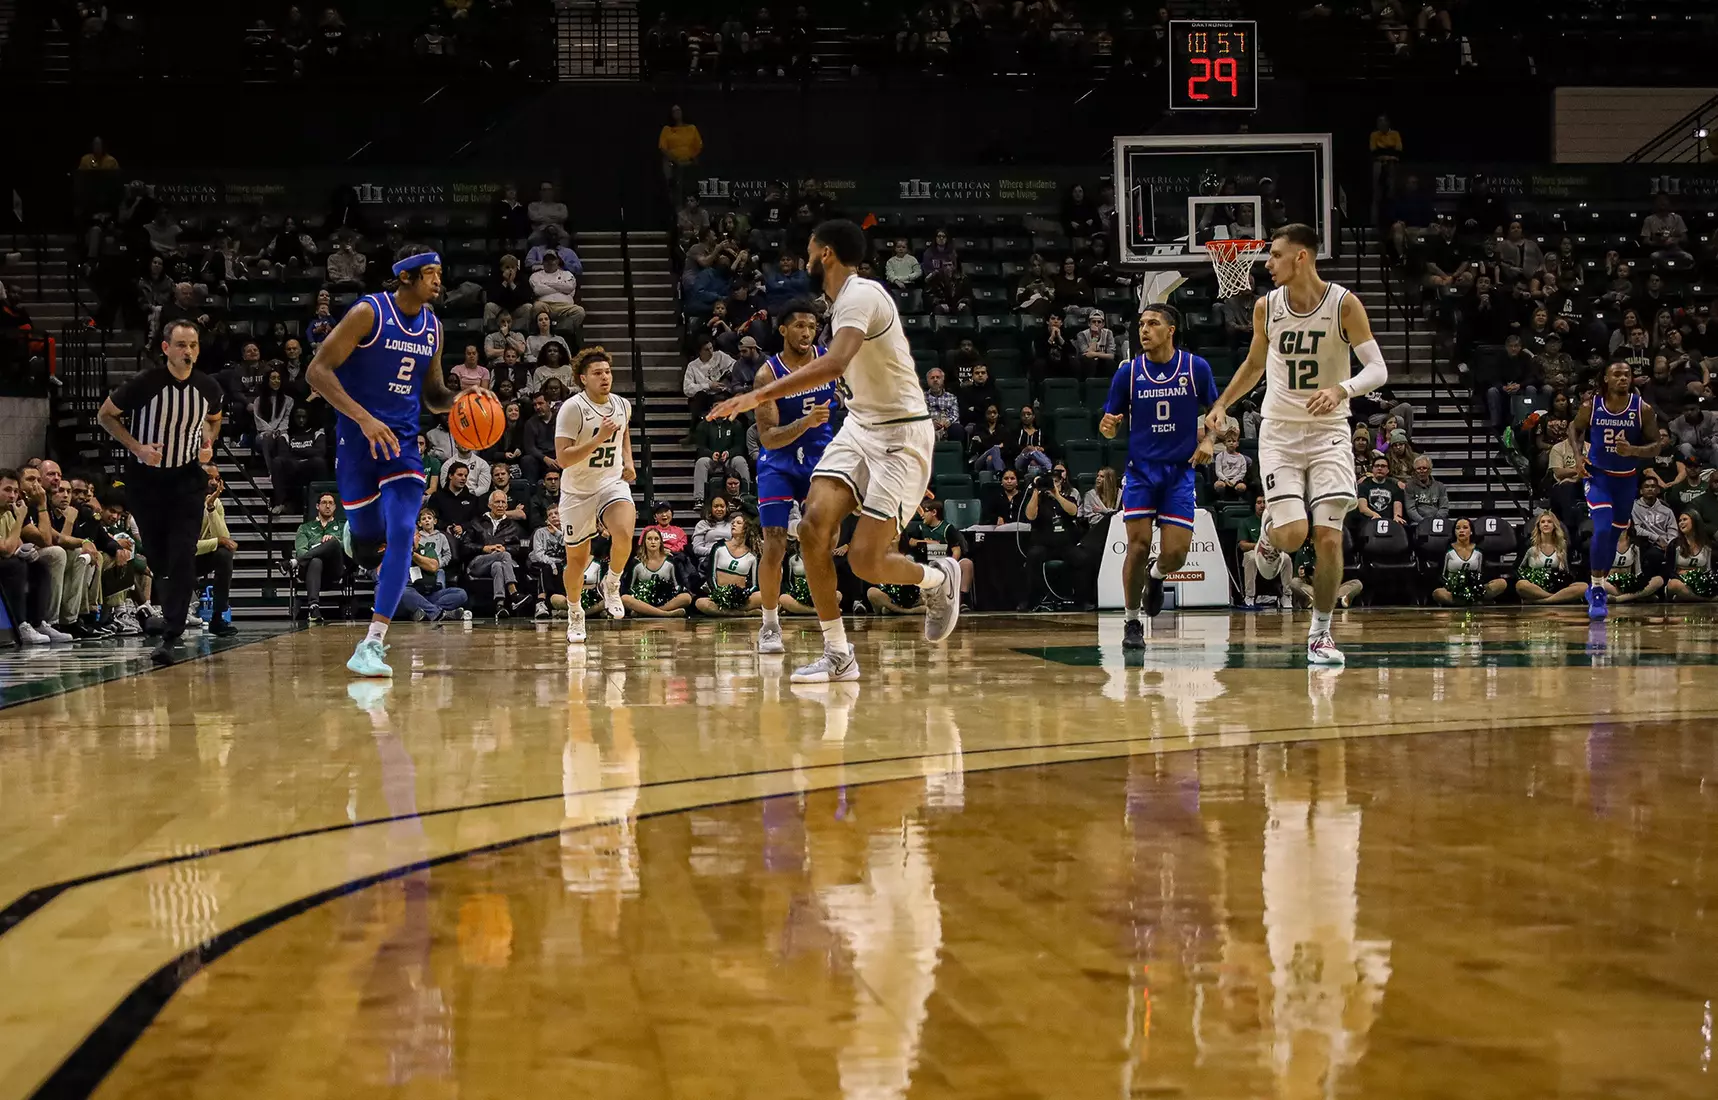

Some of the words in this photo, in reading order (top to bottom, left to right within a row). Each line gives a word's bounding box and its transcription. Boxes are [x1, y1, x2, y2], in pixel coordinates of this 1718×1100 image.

[1188, 58, 1237, 99] 29
[387, 185, 444, 194] AMERICAN
[935, 181, 990, 190] AMERICAN
[1154, 185, 1190, 193] MPUS
[387, 195, 444, 204] CAMPUS
[934, 191, 990, 199] CAMPUS
[385, 338, 433, 357] LOUISIANA
[397, 356, 416, 381] 2
[1286, 359, 1319, 390] 12
[388, 382, 413, 395] TECH
[1138, 386, 1188, 399] LOUISIANA
[802, 396, 816, 415] 5
[1156, 400, 1171, 420] 0
[1151, 423, 1176, 433] TECH
[1596, 418, 1635, 427] LOUISIANA
[1604, 428, 1626, 444] 24
[589, 446, 617, 468] 25
